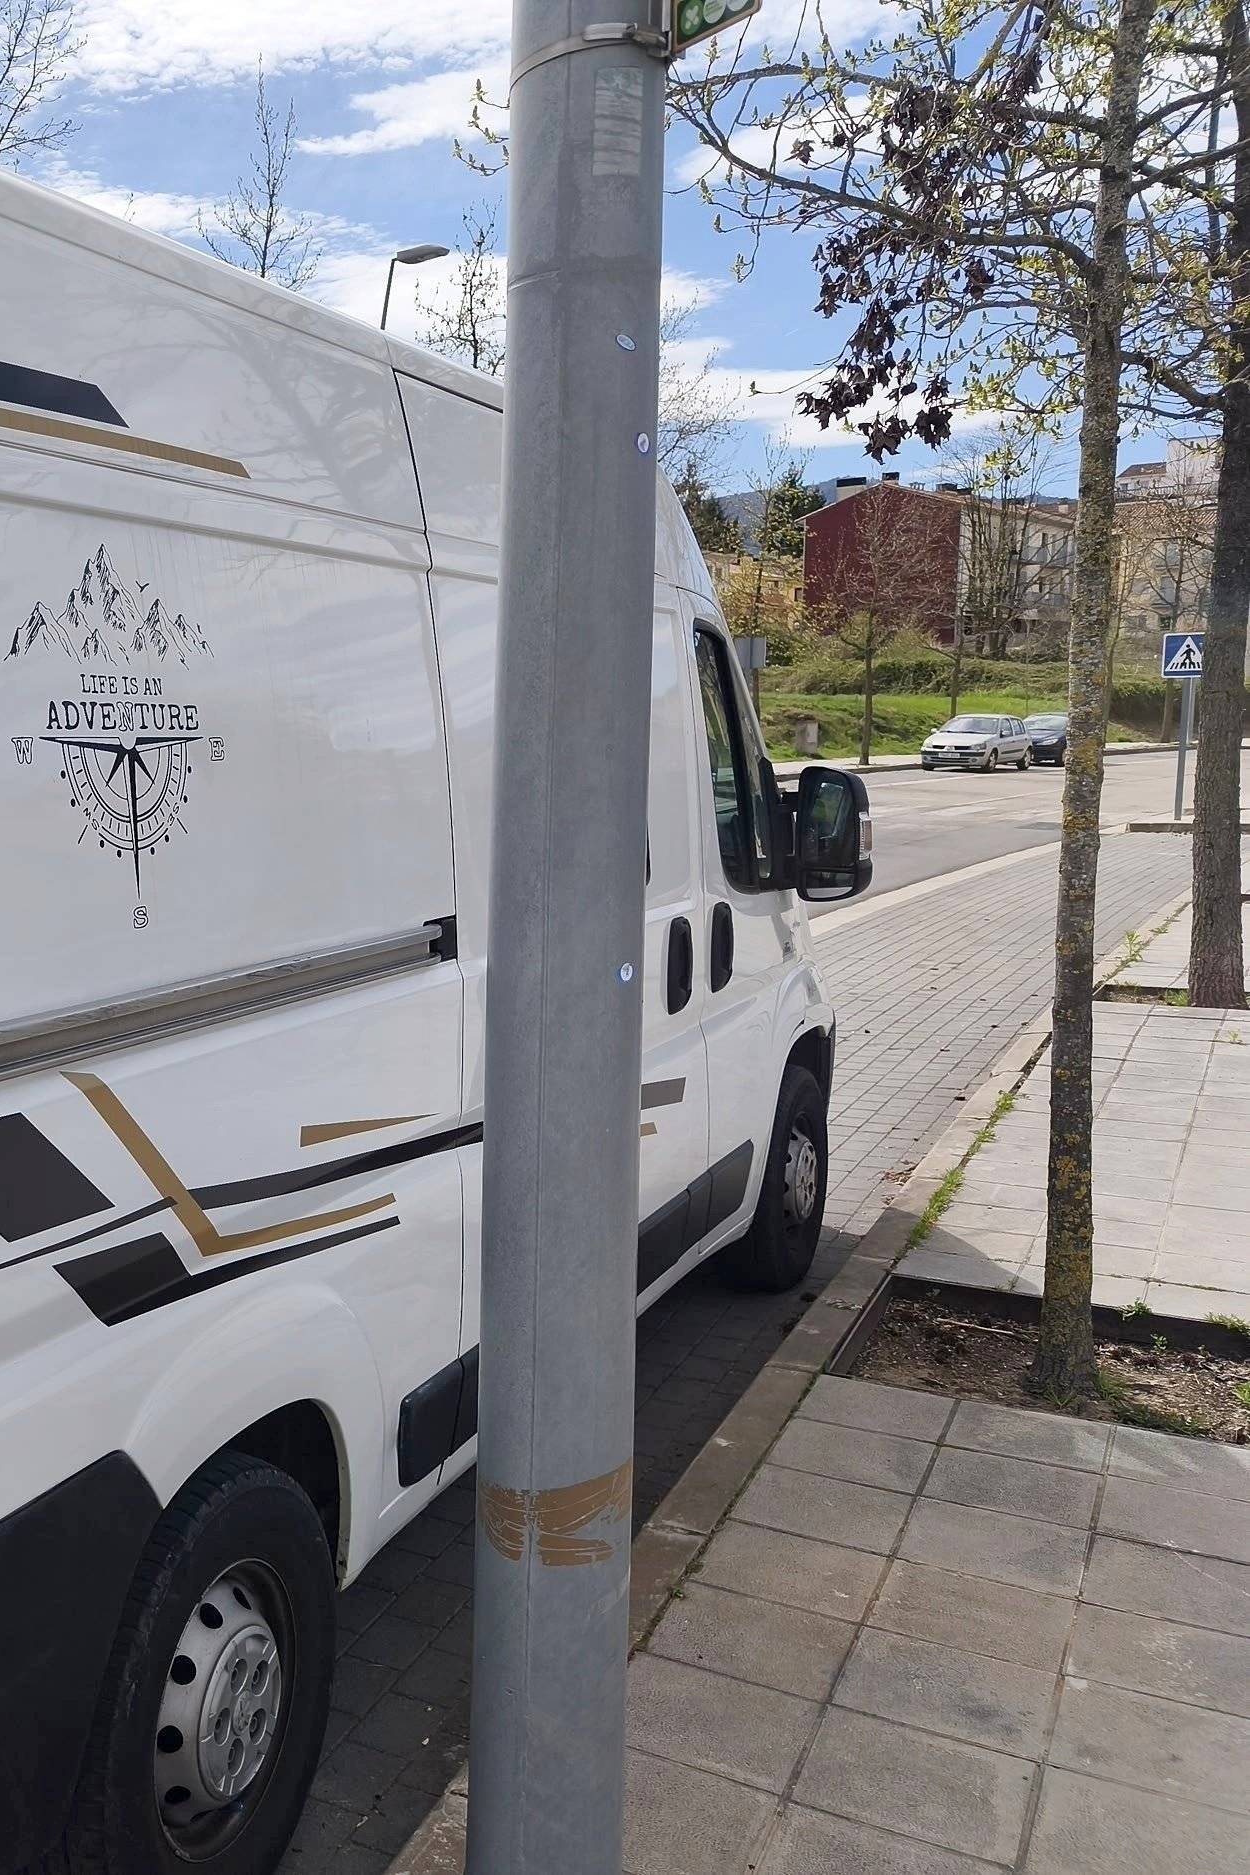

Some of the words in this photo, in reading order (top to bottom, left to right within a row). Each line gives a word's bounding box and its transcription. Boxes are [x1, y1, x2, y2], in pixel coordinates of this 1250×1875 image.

[80, 673, 118, 694] LIFE
[122, 675, 138, 695] IS
[143, 677, 162, 696] AN
[46, 700, 199, 732] ADVENTURE
[12, 737, 33, 764] W
[132, 905, 148, 929] S
